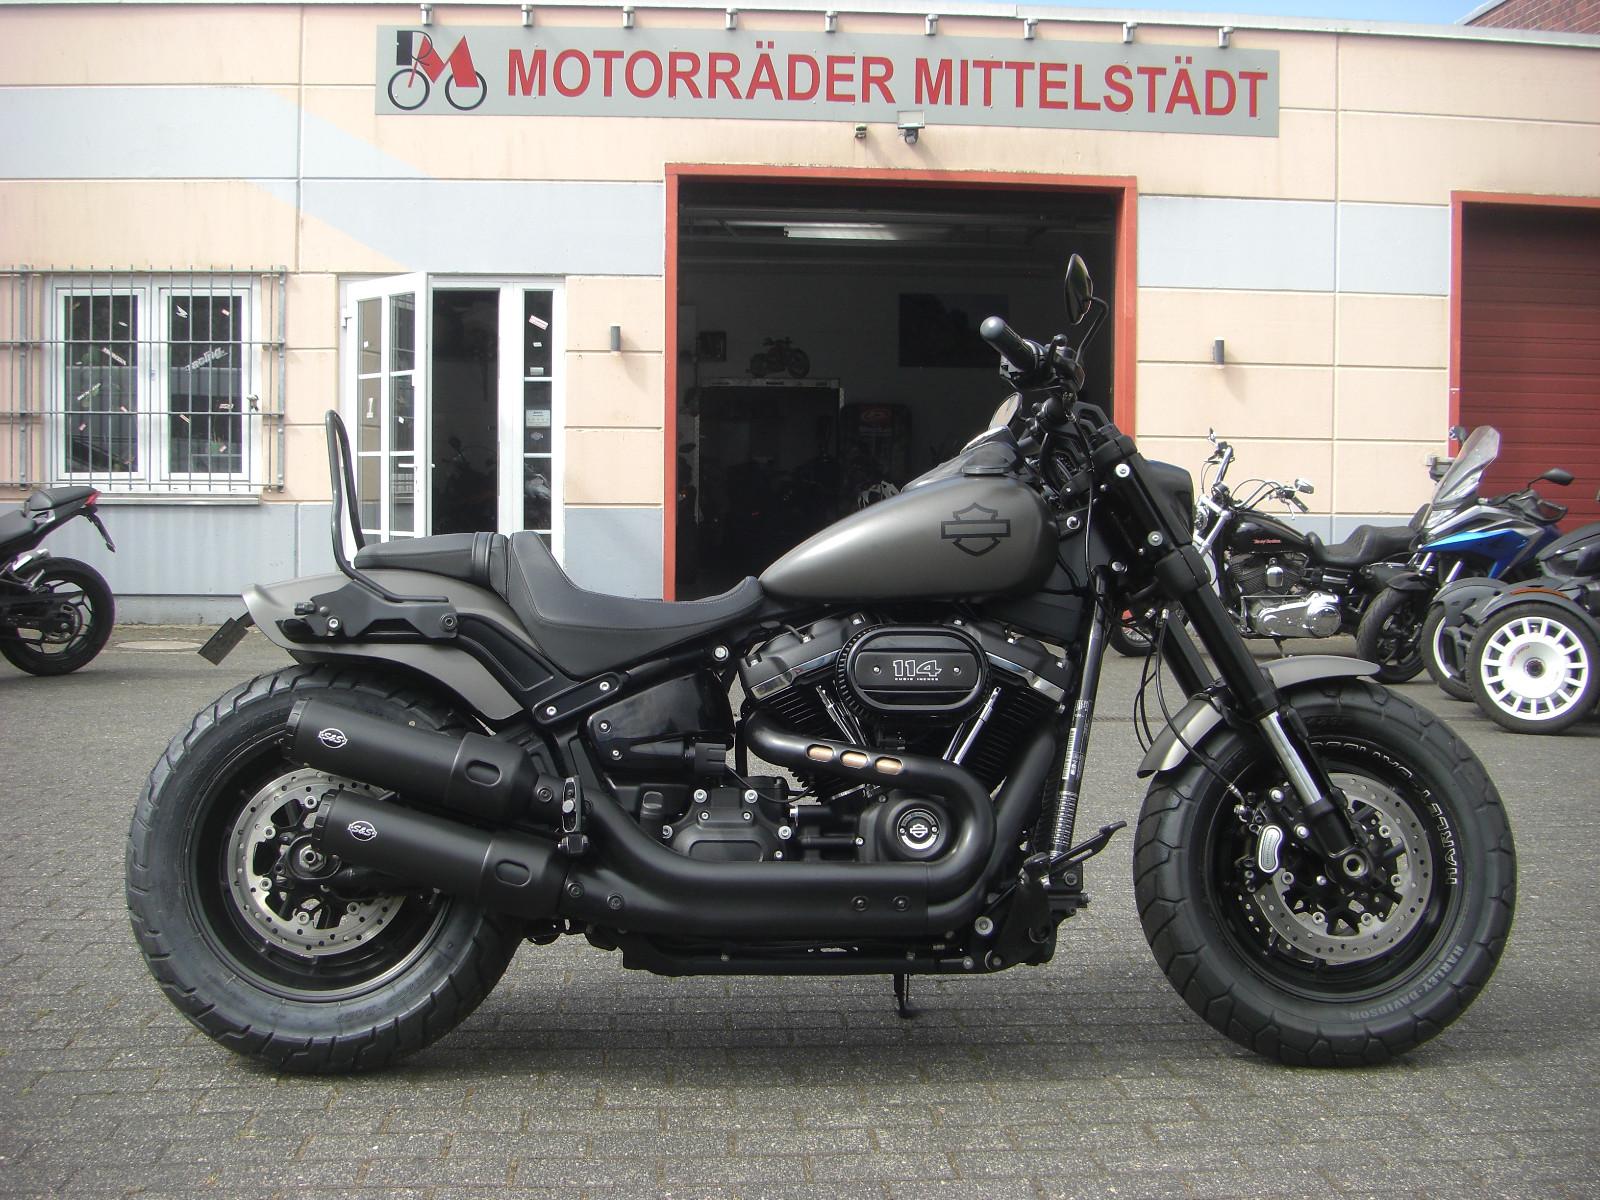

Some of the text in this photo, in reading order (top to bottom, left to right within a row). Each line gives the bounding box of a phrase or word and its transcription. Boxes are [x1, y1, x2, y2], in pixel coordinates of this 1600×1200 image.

[508, 41, 1269, 118] MOTORRÄDER MITTELSTÄDT
[893, 659, 943, 677] 114
[1349, 944, 1465, 1021] HARLEY-DAVIDSON
